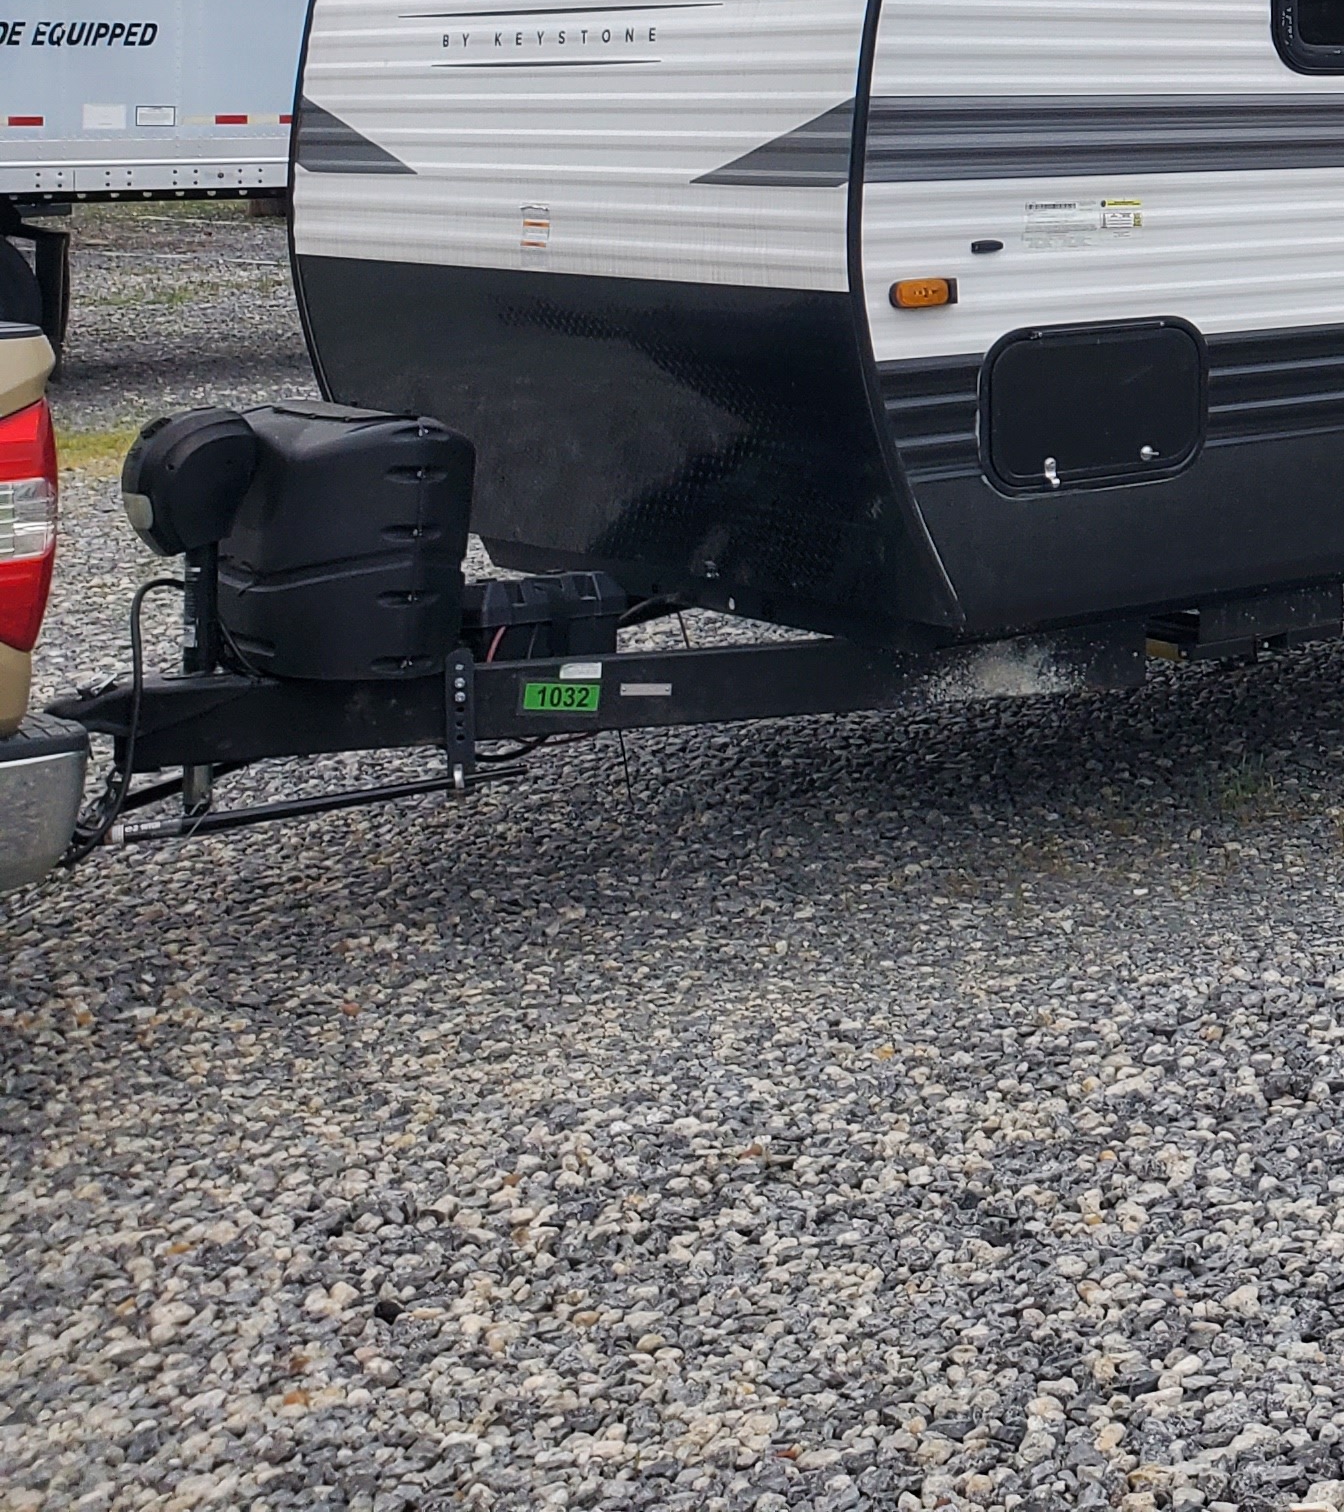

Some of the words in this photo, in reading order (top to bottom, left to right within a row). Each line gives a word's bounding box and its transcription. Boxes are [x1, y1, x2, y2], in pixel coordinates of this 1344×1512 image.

[31, 21, 158, 47] EQUIPPED
[442, 33, 470, 48] BY
[494, 27, 657, 46] KEYSTONE
[537, 686, 590, 708] 1032
